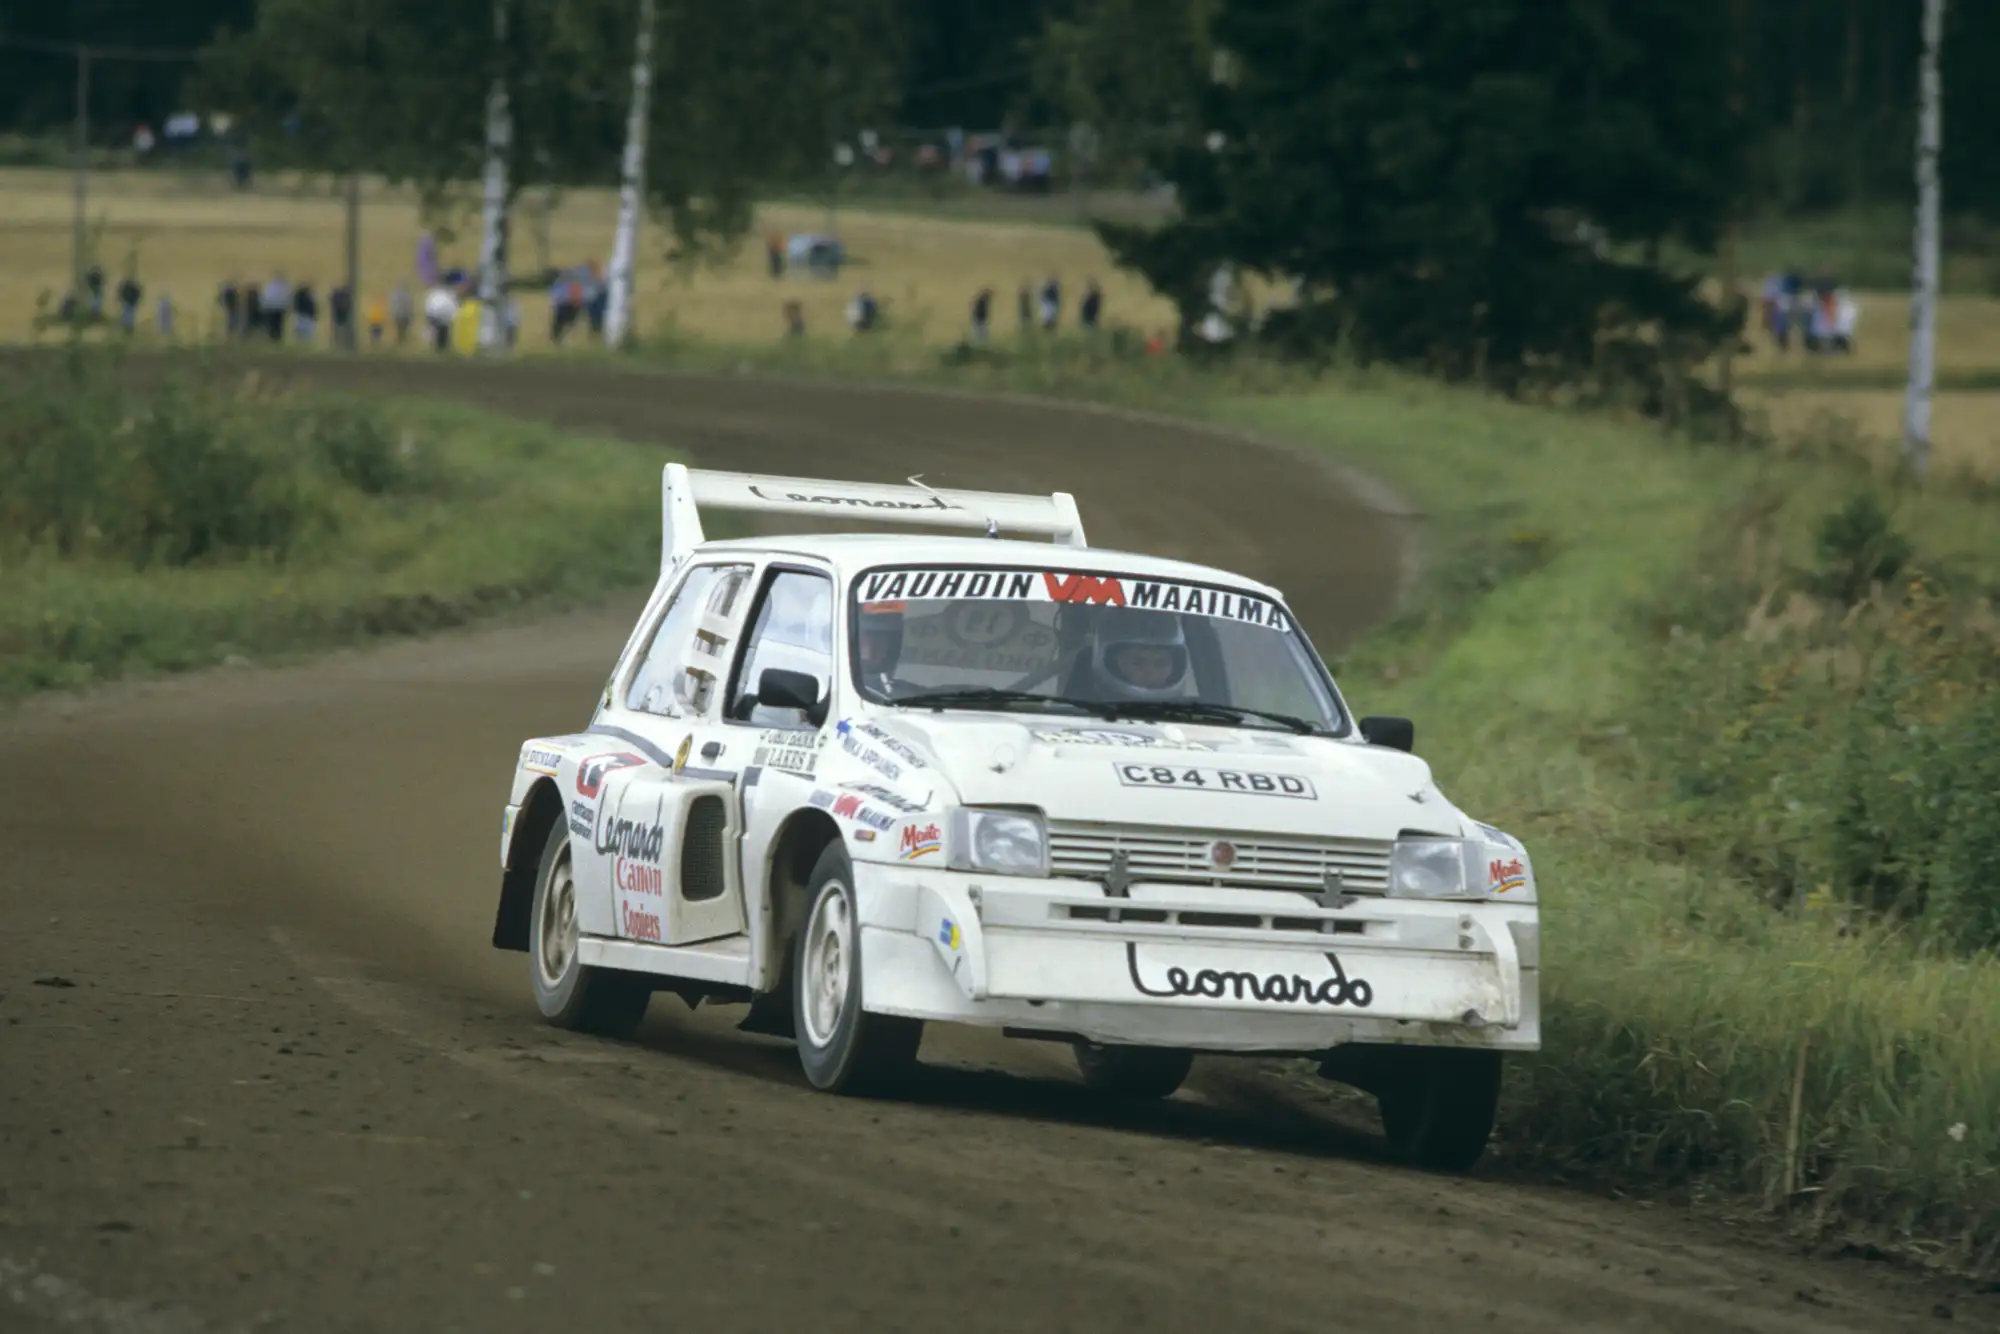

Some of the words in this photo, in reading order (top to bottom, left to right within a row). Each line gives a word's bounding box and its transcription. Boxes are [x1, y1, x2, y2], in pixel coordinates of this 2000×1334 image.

[866, 572, 1034, 600] VAUHDIN
[1042, 572, 1128, 608] VM
[1131, 582, 1288, 631] MAAILMA
[528, 750, 562, 768] DUNLOP
[1122, 765, 1206, 787] C84
[1218, 771, 1306, 793] RBD
[596, 783, 664, 863] Leonardo
[616, 856, 662, 897] Canon
[622, 900, 661, 941] Copiers
[1126, 941, 1373, 1007] Leonardo
